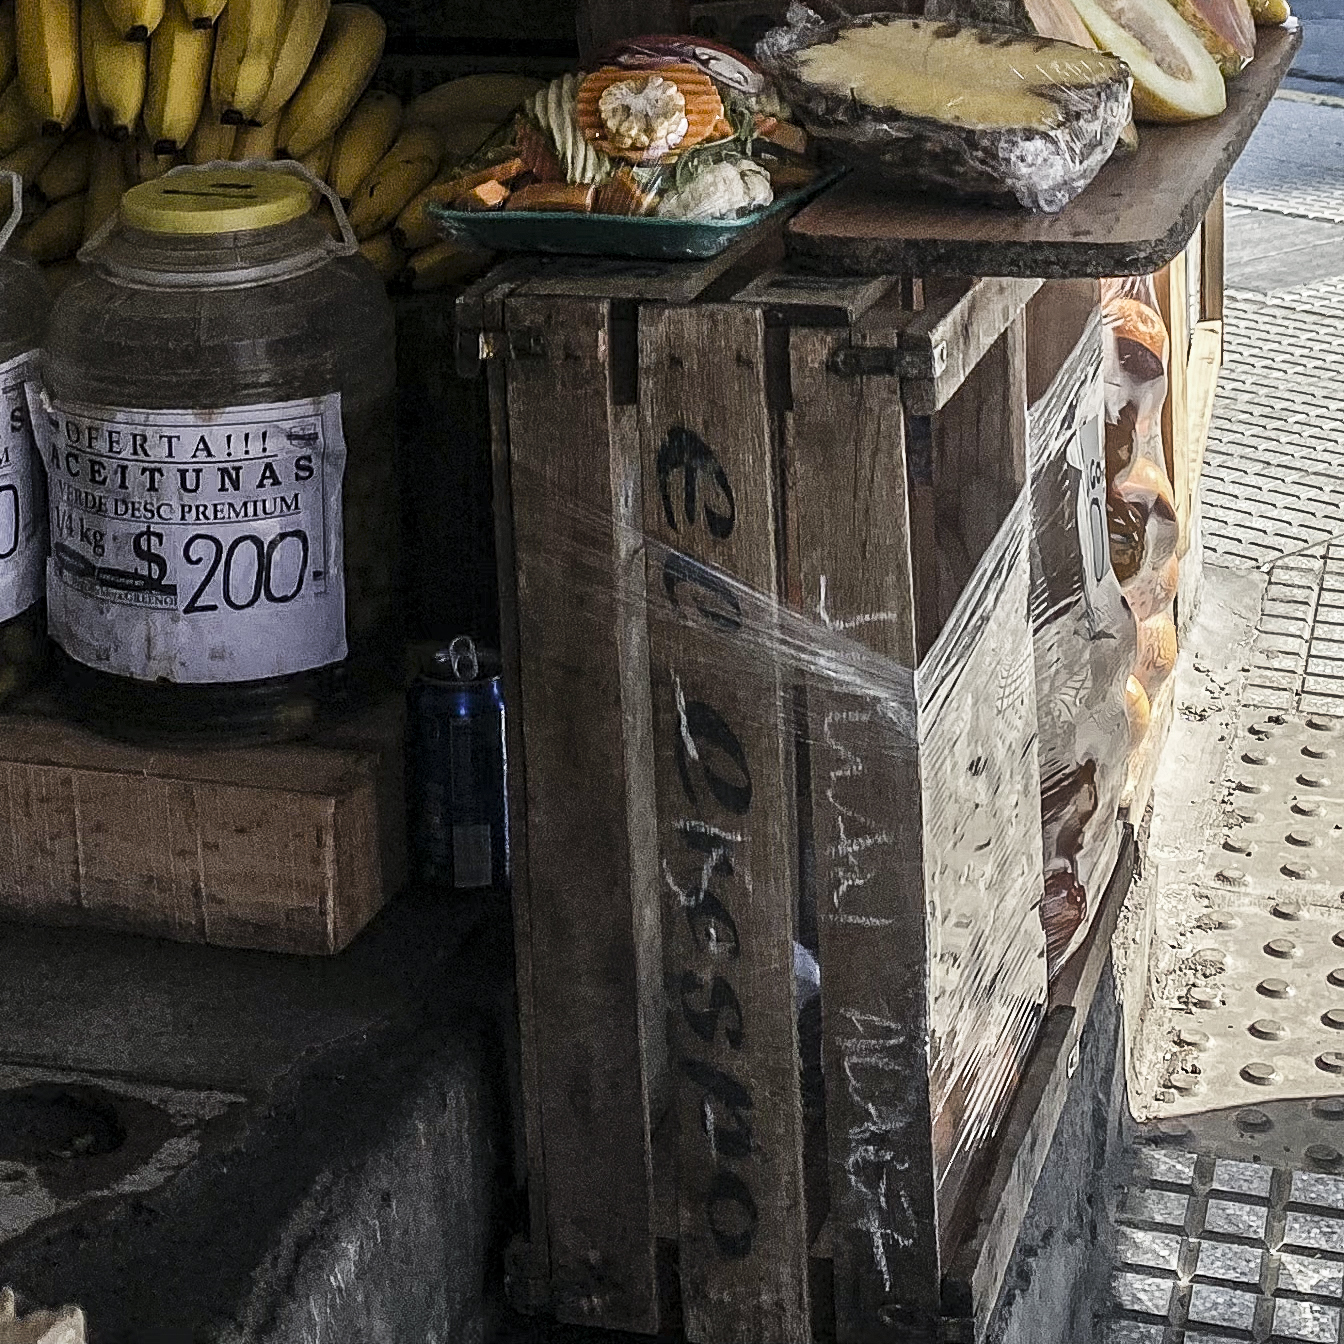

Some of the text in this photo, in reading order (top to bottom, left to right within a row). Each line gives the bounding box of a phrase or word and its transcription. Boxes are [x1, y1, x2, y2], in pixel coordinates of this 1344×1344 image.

[65, 420, 269, 460] OFERTA!!!
[52, 442, 315, 494] ACEITUNAS
[179, 492, 302, 522] PREMIUM
